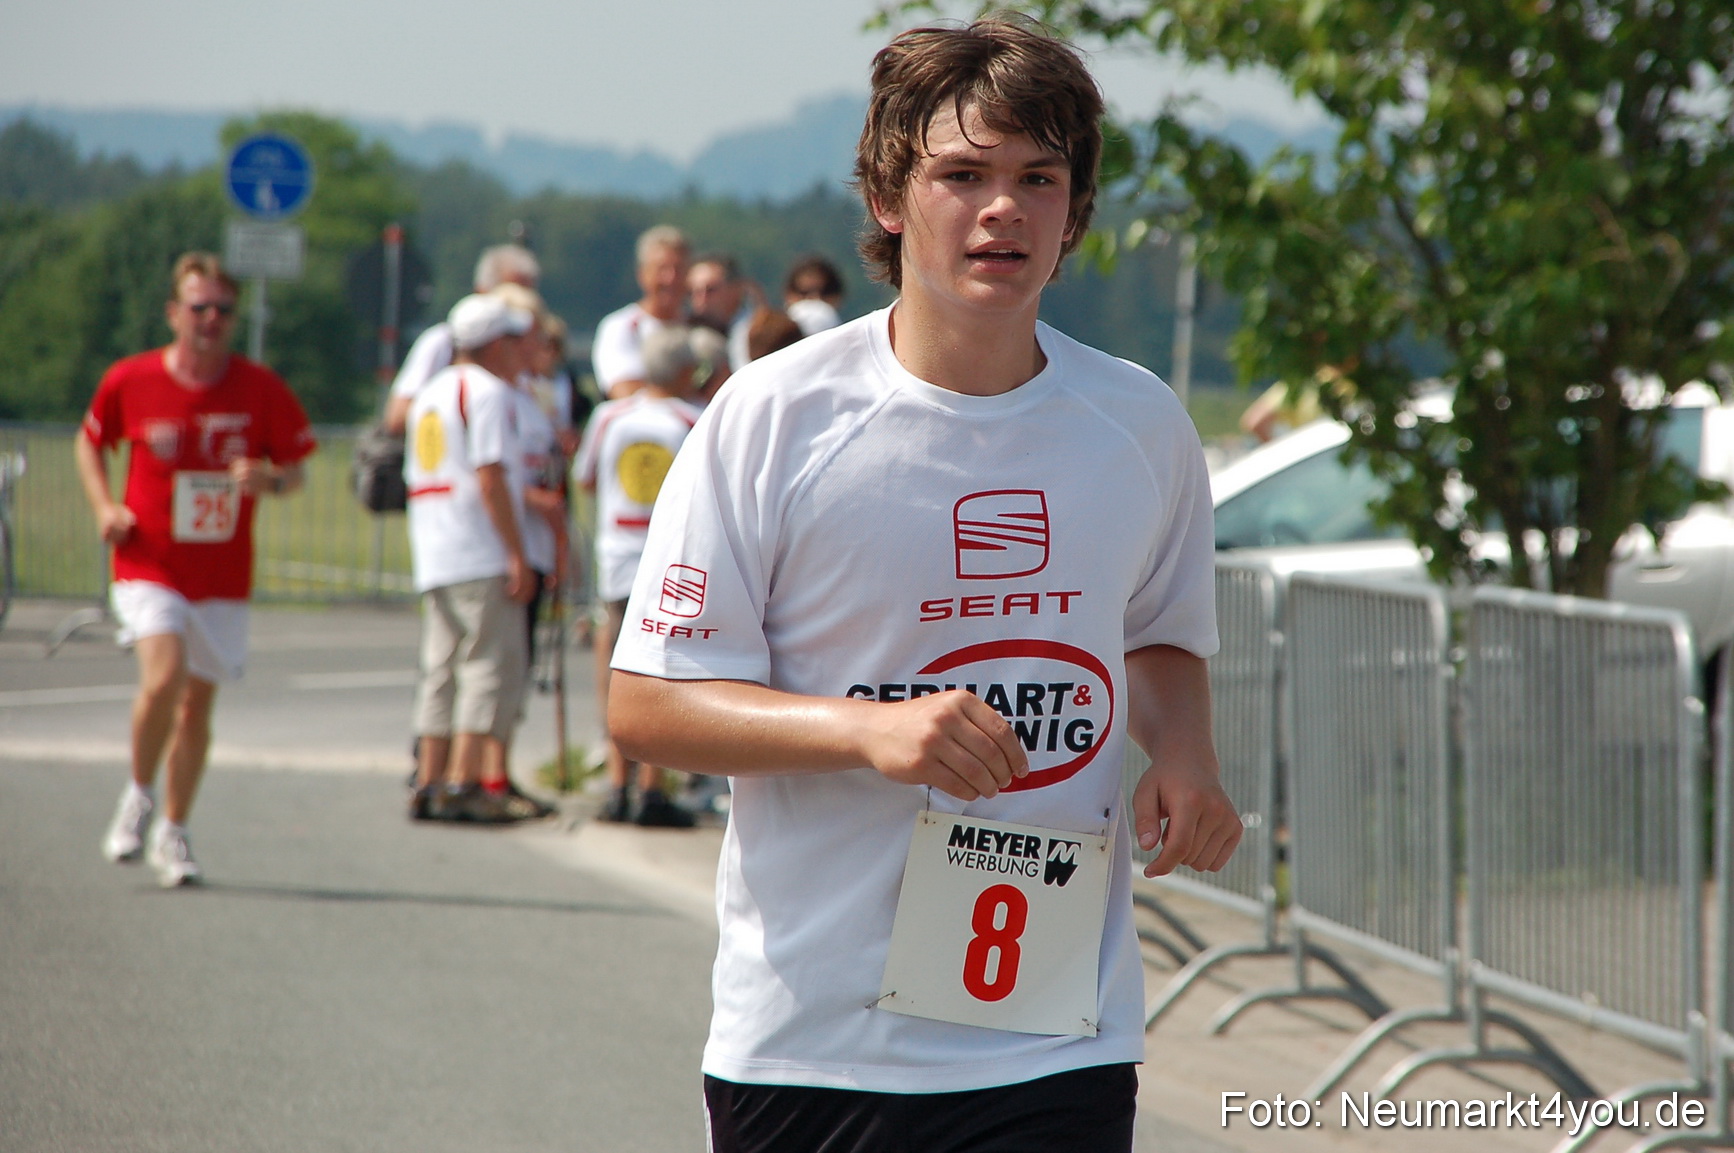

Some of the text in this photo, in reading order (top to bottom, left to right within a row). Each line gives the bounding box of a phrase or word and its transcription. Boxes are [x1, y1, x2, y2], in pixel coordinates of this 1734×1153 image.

[919, 591, 1082, 622] SEAT
[641, 618, 719, 639] SEAT
[947, 823, 1041, 860] MEYER
[946, 848, 1040, 878] WERBUNG
[962, 883, 1029, 1002] 8
